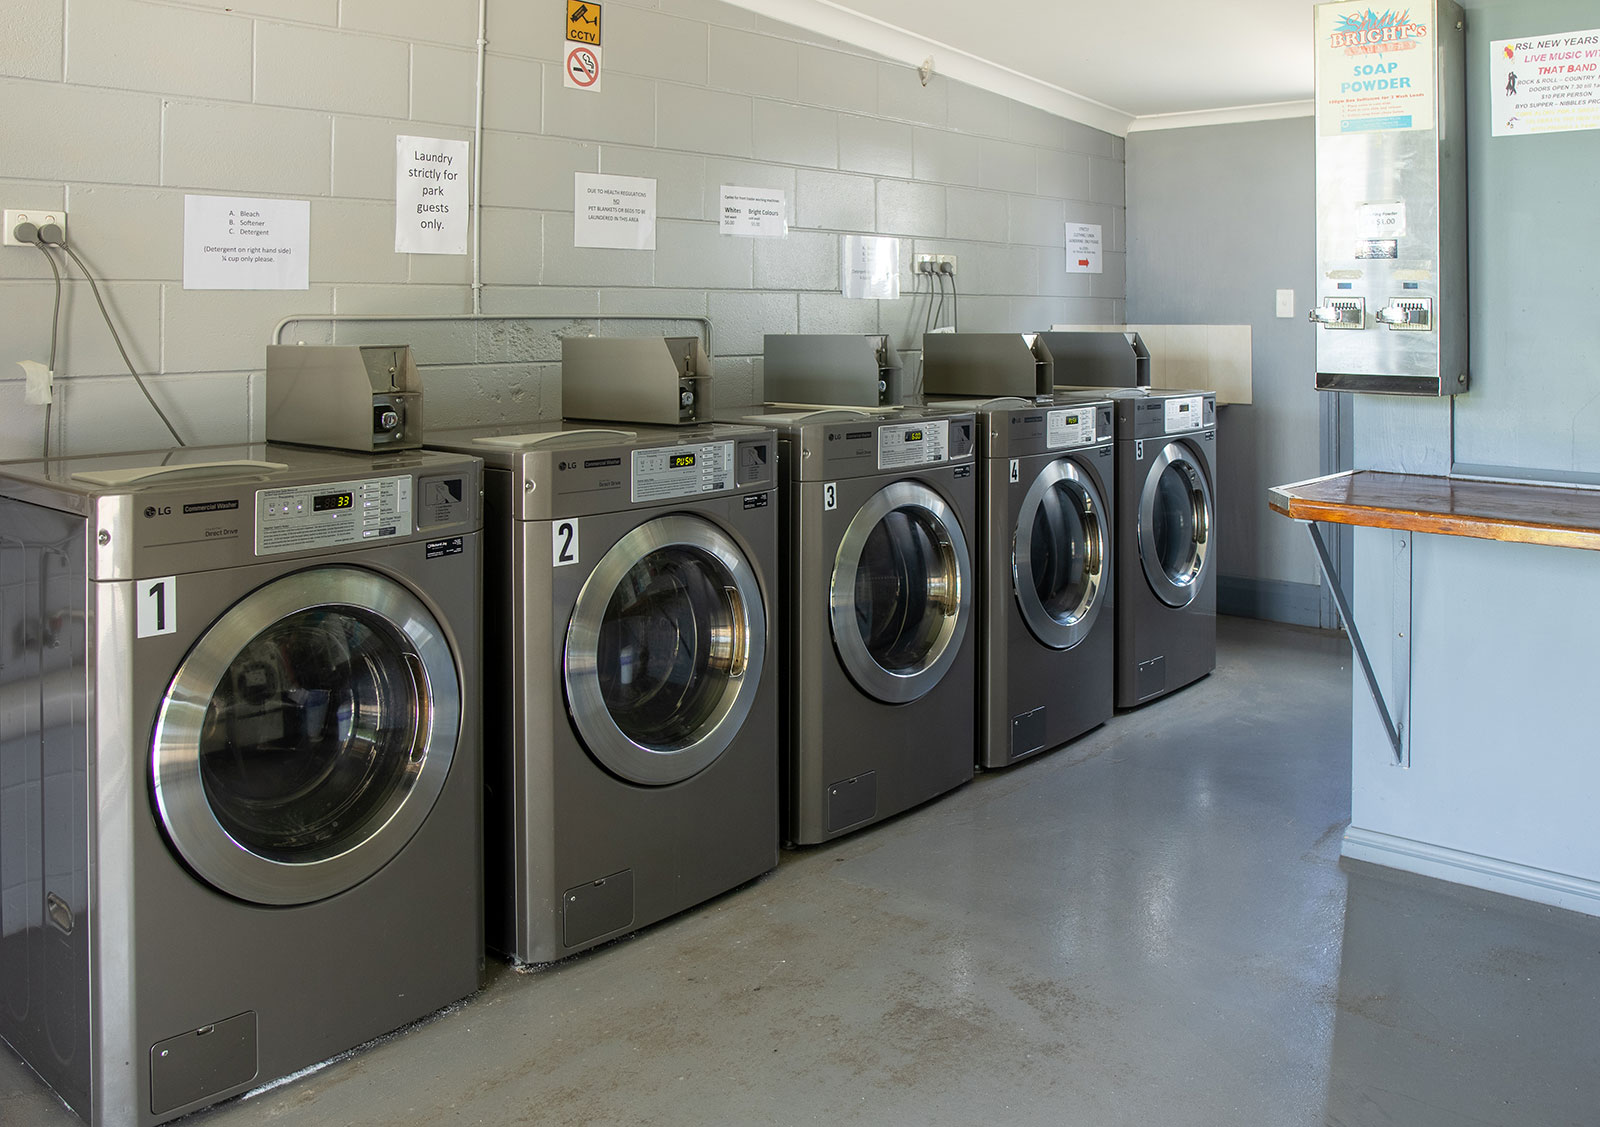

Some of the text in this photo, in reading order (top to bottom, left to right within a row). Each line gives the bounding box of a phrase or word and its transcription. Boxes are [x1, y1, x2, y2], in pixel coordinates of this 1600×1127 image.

[1346, 9, 1410, 31] Shiny
[570, 29, 596, 41] CCTV
[1515, 36, 1598, 51] RSL NEW YEARS
[1524, 54, 1547, 63] LIVE
[1548, 51, 1582, 61] MUSIC
[1353, 62, 1398, 77] SOAP
[1538, 63, 1597, 75] THAT BAND
[1340, 77, 1411, 94] POWDER
[415, 150, 453, 166] Laundry
[408, 168, 458, 181] strictly for
[422, 186, 444, 197] park
[620, 190, 647, 198] REGULATIONS
[417, 203, 449, 214] guests
[748, 208, 761, 216] Bright
[762, 209, 779, 217] Colours
[420, 218, 445, 231] only.
[240, 228, 269, 236] Detergent
[204, 245, 236, 254] (Detergent
[247, 246, 261, 254] right
[240, 255, 253, 263] only
[1138, 441, 1143, 460] 5
[676, 456, 694, 466] PUSH
[1012, 461, 1018, 481] 4
[826, 486, 834, 507] 3
[184, 503, 217, 513] Commercial
[217, 502, 238, 510] Washer
[205, 529, 222, 537] Direct
[558, 522, 574, 566] 2
[148, 582, 166, 630] 1
